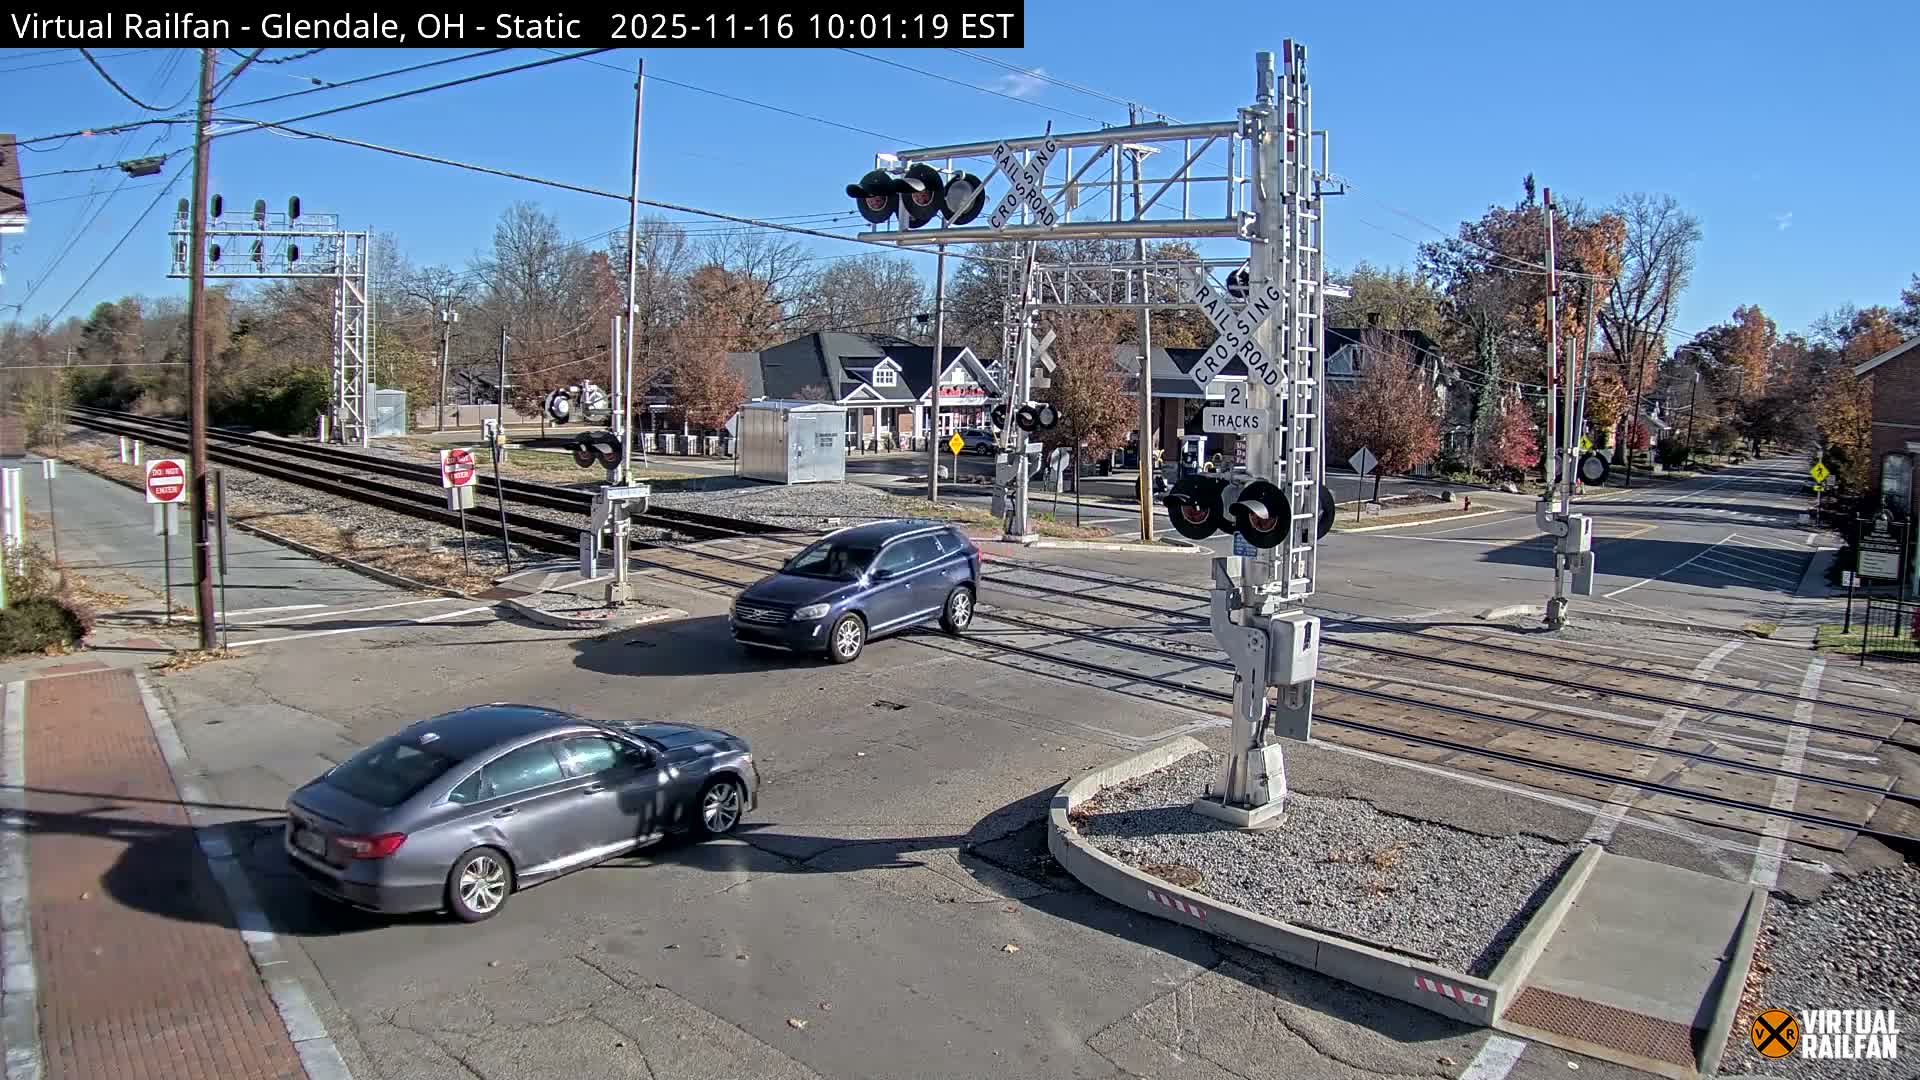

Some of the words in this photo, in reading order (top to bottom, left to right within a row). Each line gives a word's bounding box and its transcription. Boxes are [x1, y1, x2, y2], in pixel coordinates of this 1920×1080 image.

[991, 140, 1056, 228] CROSSING
[993, 145, 1054, 226] RAILROAD
[1195, 286, 1280, 383] CROSSING
[1196, 286, 1278, 386] RAILROAD
[1230, 388, 1240, 404] 2
[1212, 415, 1259, 429] TRACKS
[152, 468, 162, 476] DO
[165, 467, 179, 475] NOT
[155, 486, 177, 494] ENTER
